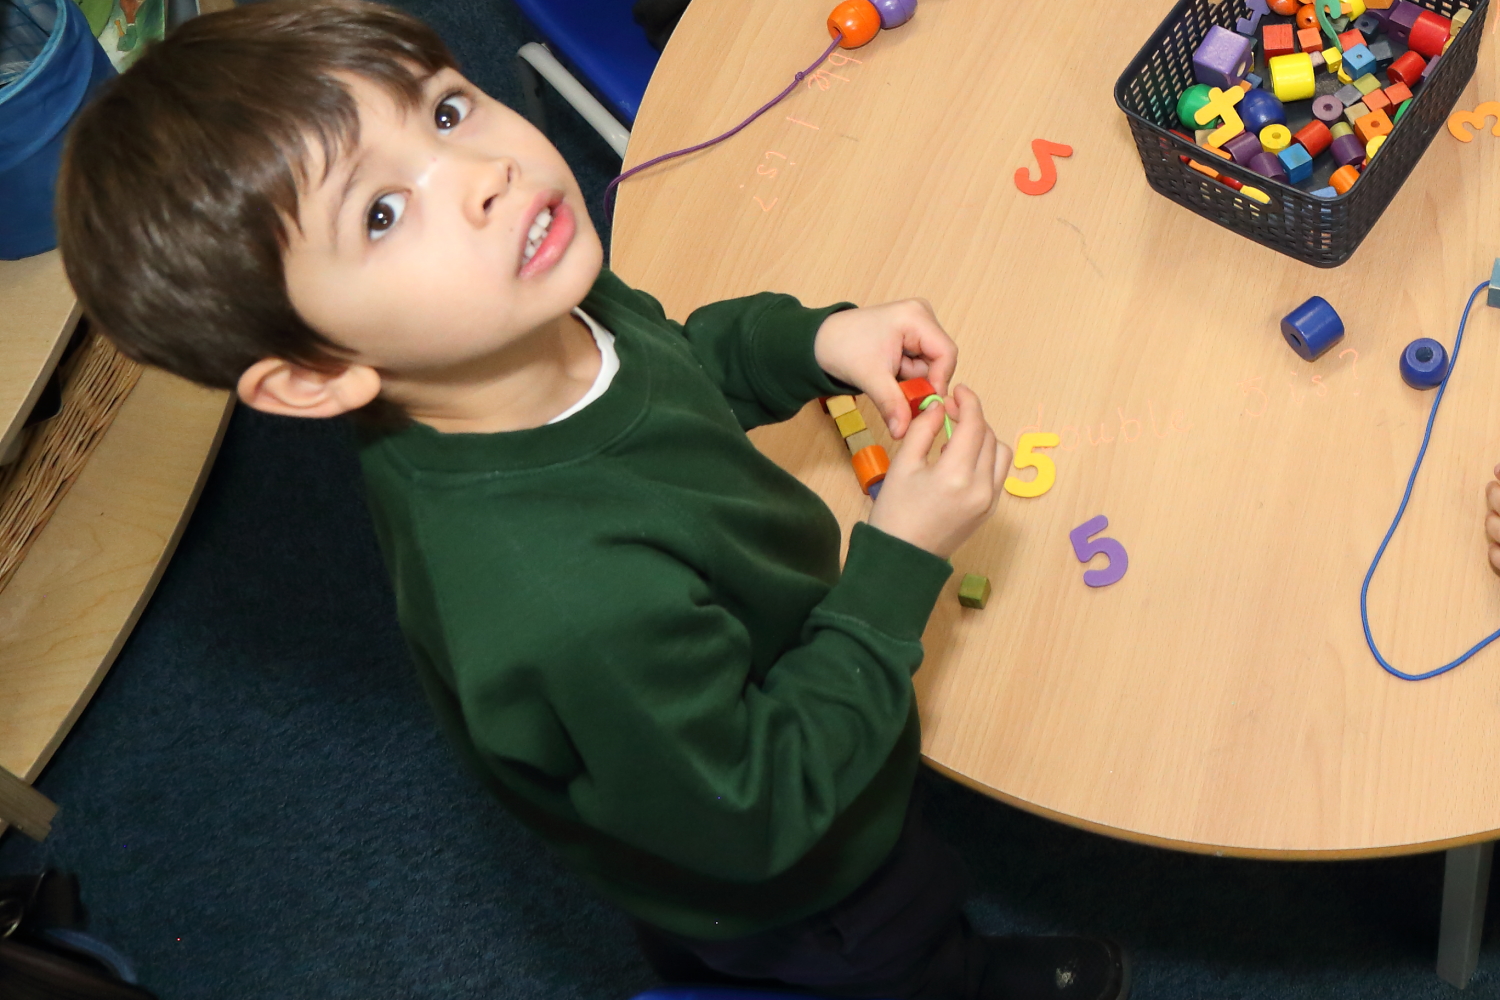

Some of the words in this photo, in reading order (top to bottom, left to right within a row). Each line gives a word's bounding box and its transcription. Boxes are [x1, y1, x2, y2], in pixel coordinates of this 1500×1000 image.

[808, 52, 863, 92] ble
[1014, 400, 1194, 452] double
[1237, 375, 1269, 417] 5
[1004, 433, 1060, 498] 5
[1069, 514, 1129, 588] 5
